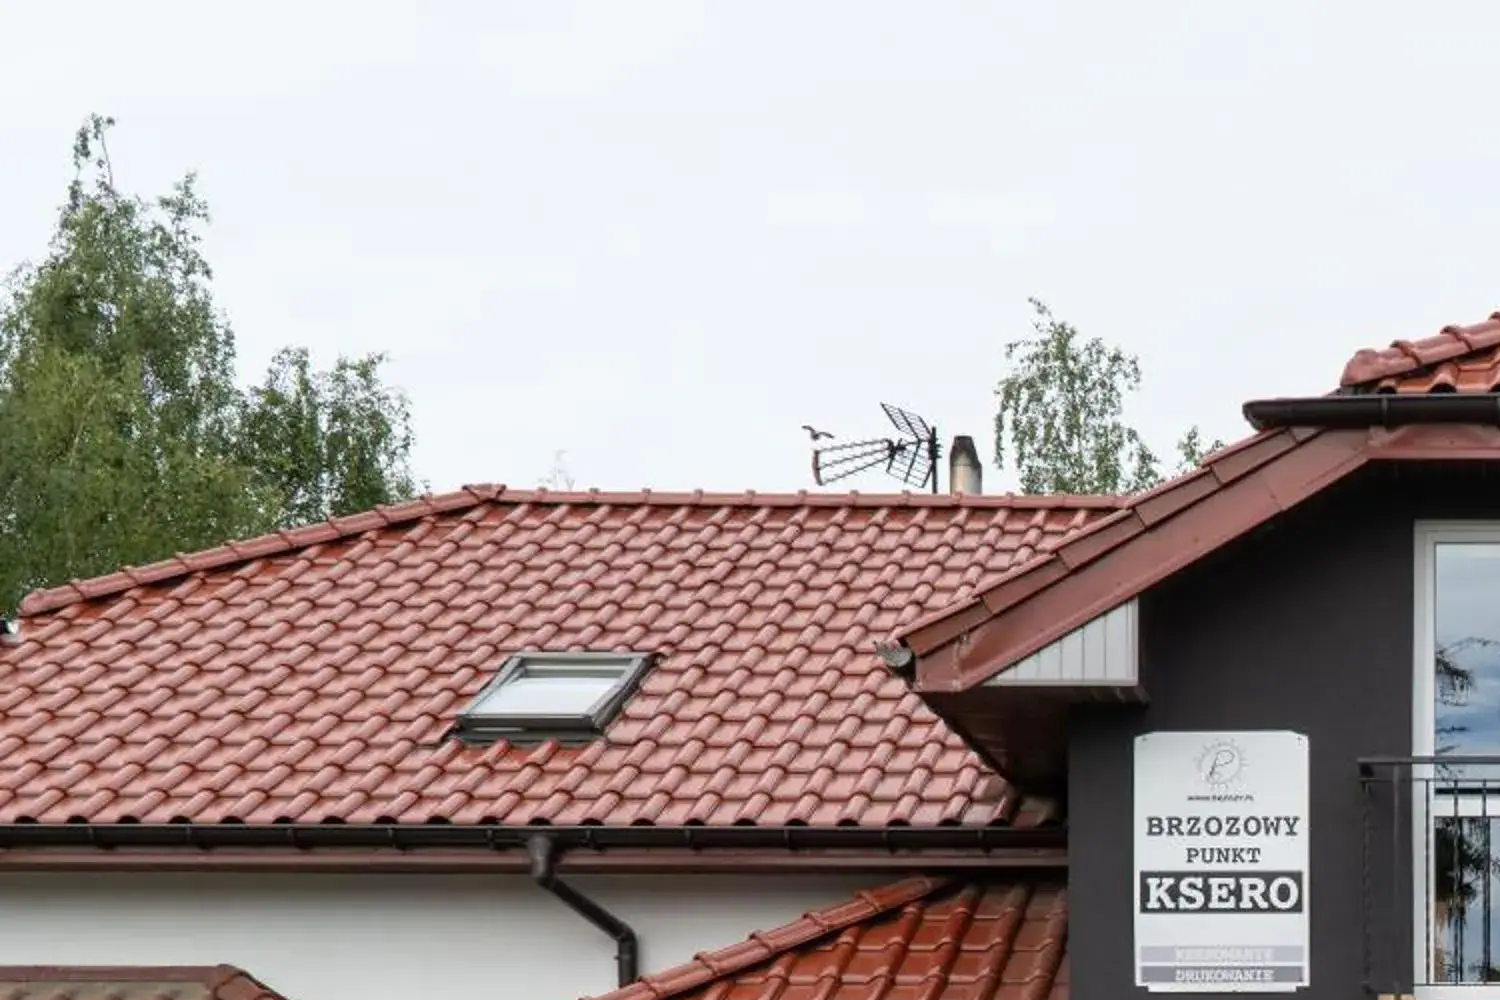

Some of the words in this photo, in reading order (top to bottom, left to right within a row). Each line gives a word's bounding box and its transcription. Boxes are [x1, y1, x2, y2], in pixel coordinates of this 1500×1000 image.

[1147, 817, 1299, 837] BRZOZOWY
[1187, 848, 1261, 863] PUNKT
[1146, 877, 1299, 910] KSERO
